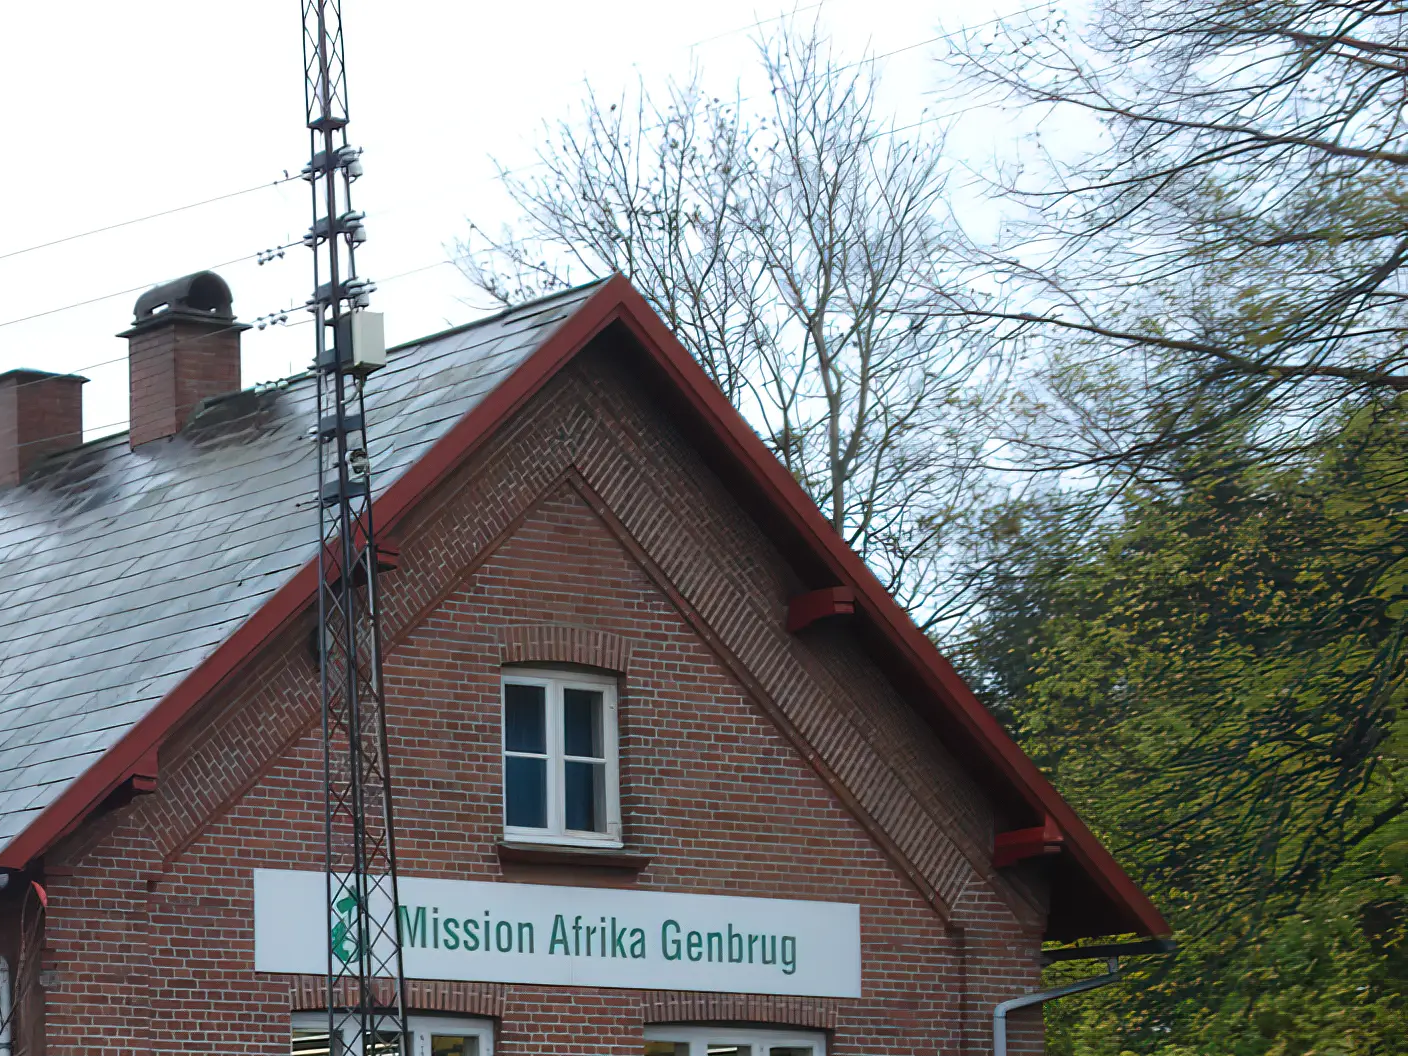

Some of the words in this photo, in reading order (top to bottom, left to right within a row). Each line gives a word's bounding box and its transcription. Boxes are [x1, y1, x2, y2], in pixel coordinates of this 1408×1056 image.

[398, 905, 535, 954] Mission
[548, 914, 646, 958] Afrika
[661, 919, 797, 975] Genbrug
